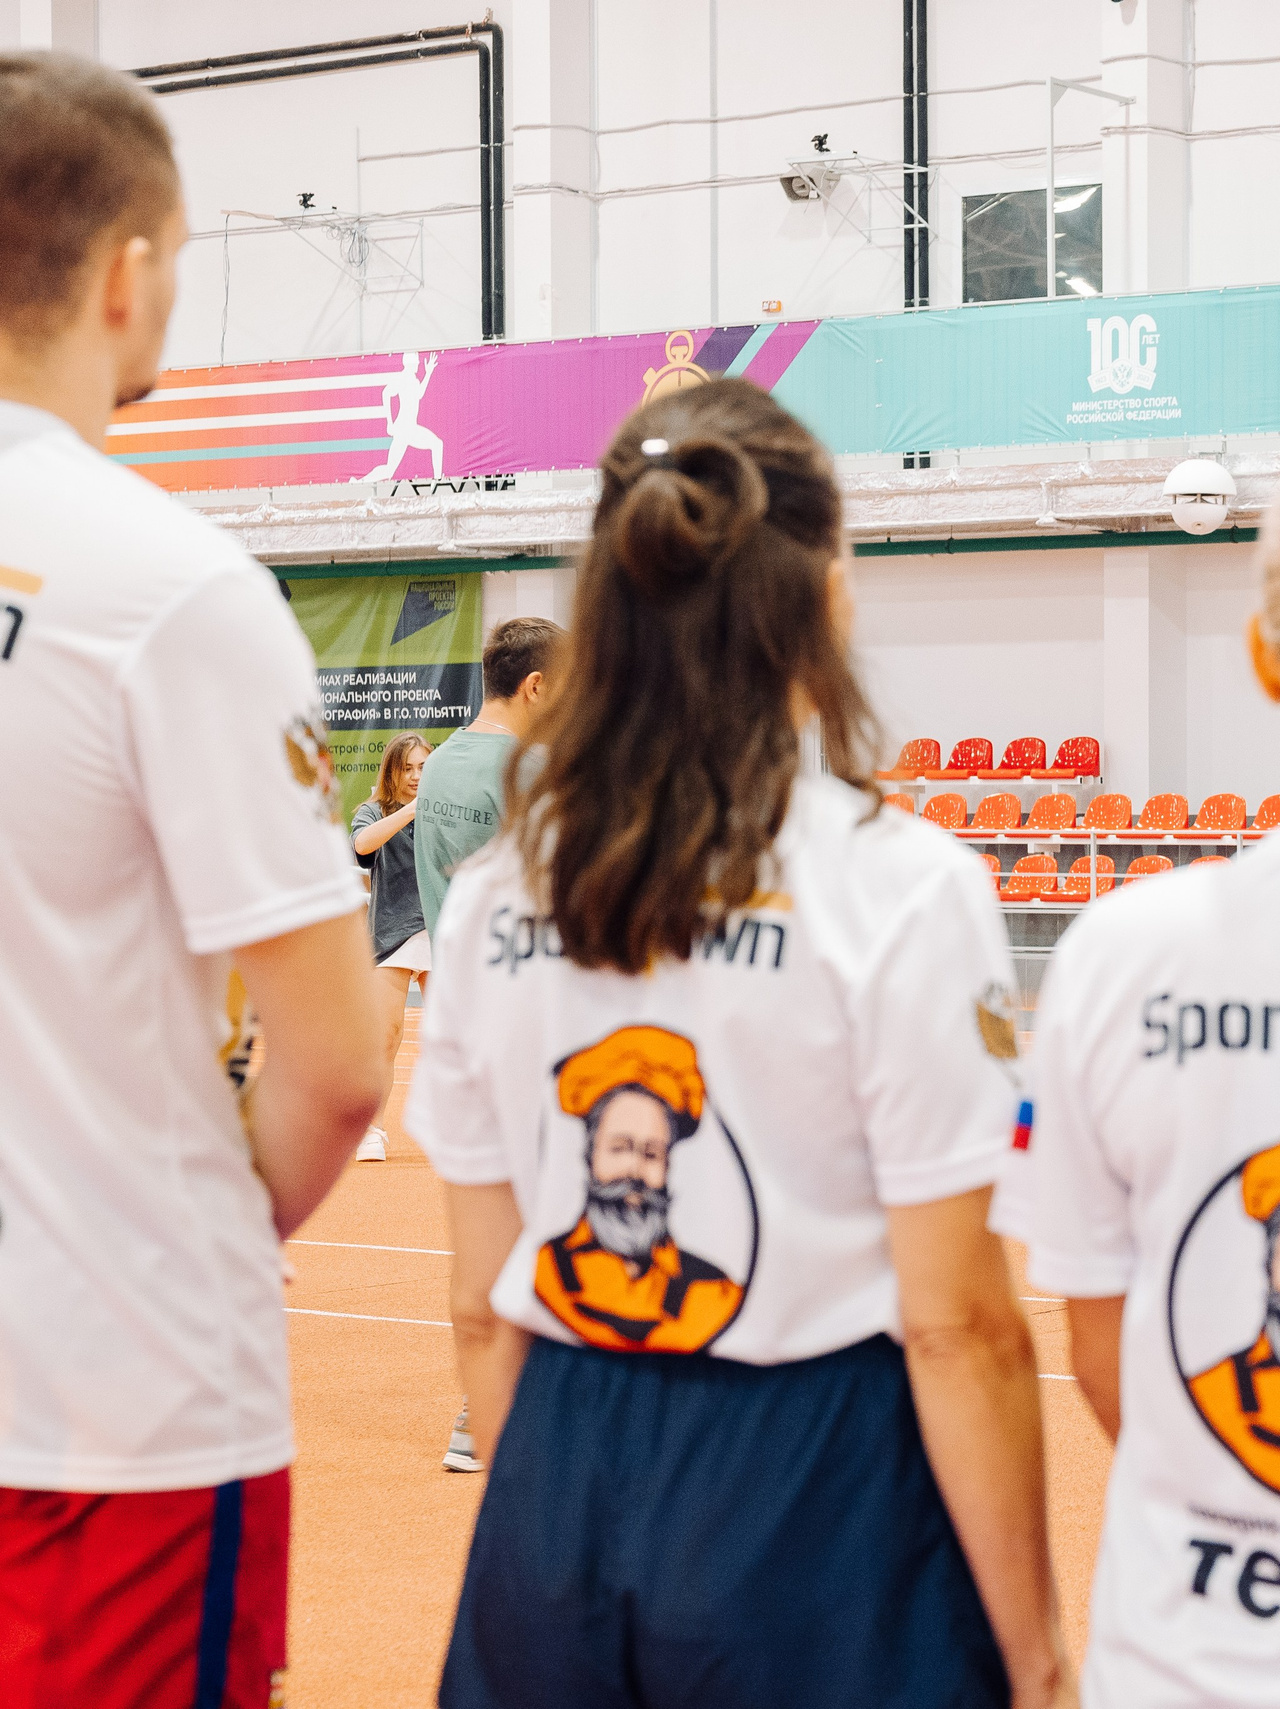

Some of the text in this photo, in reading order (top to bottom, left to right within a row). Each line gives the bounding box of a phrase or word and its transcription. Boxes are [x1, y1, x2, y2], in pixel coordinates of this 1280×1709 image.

[1142, 333, 1160, 345] ЛЕТ
[1072, 396, 1178, 412] МИНИСТЕРСТВО СПОРТА
[1066, 408, 1181, 424] РОССИЙСКОЙ ФЕДЕРАЦИИ
[428, 591, 455, 602] ПРОЕКТЫ
[343, 672, 417, 686] РЕАЛИЗАЦИИ
[318, 689, 441, 704] ИОНАЛЬНОГО ПРОЕКТА
[322, 706, 472, 721] ОГРАФИЯ» В Г.О. ТОЛЬЯТТИ
[329, 741, 385, 757] строен Об
[433, 801, 493, 826] COUTURE
